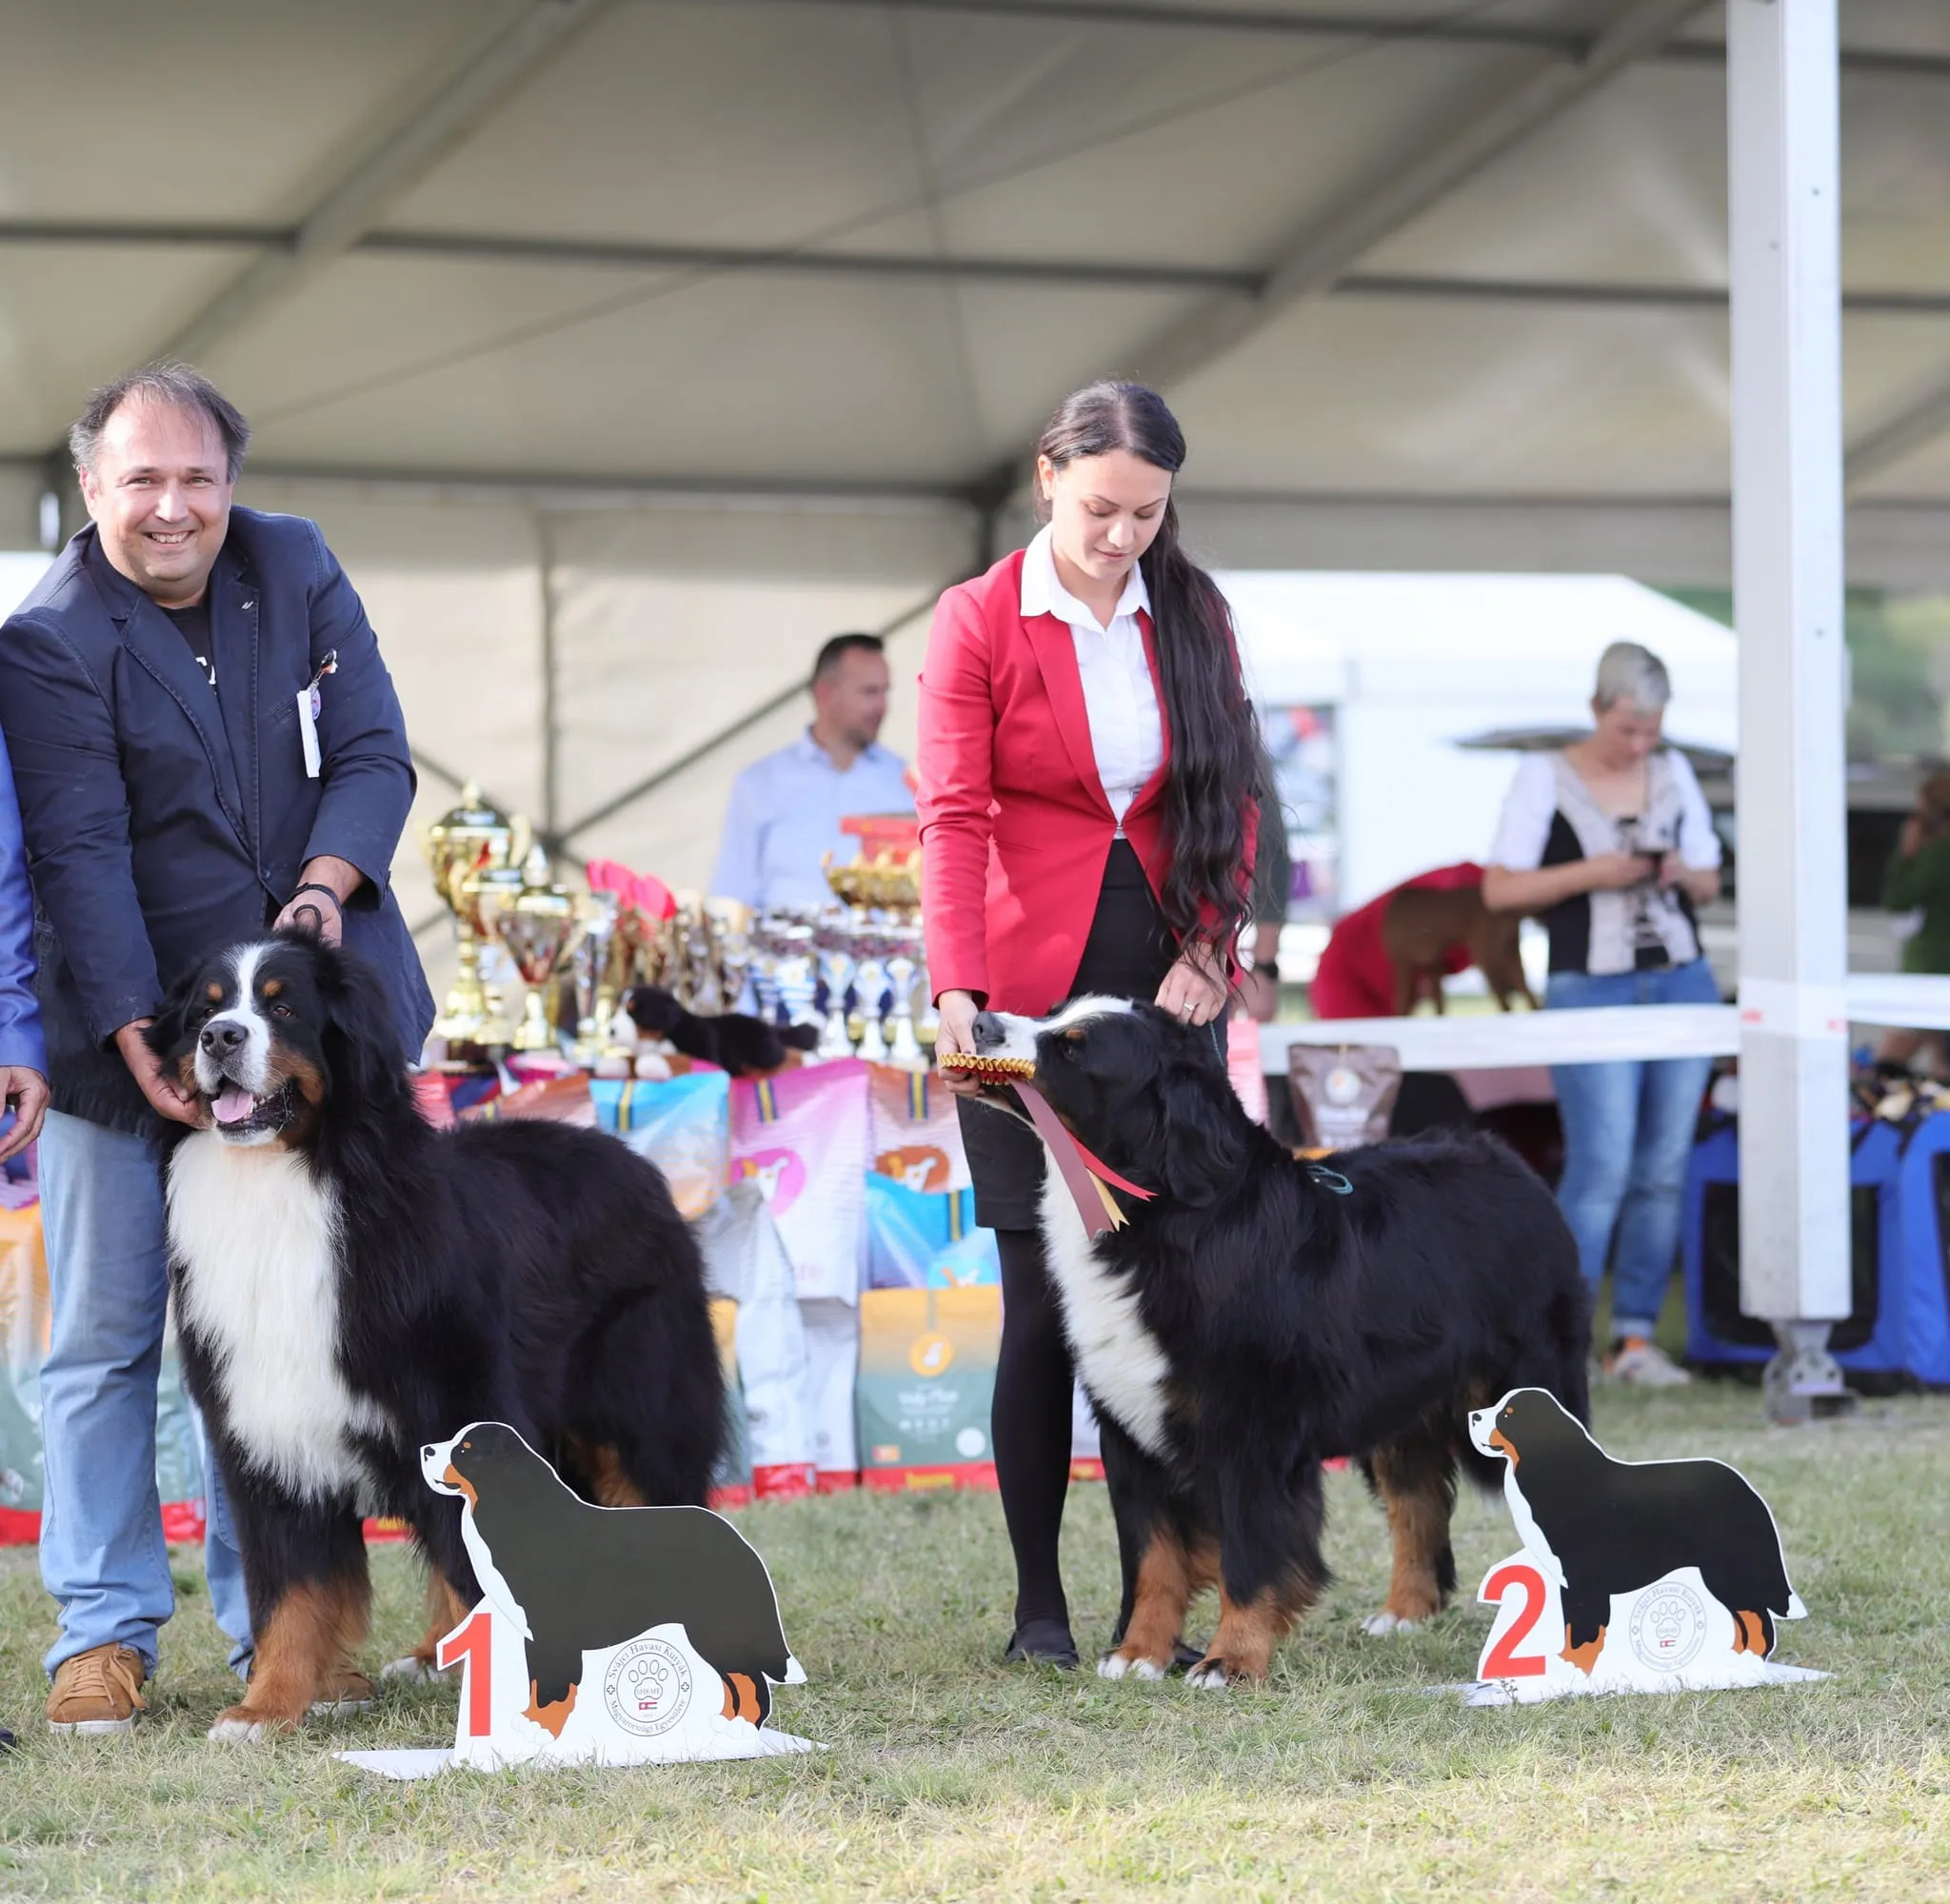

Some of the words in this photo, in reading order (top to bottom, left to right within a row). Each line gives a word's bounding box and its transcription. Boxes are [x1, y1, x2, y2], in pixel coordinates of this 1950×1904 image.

[443, 1613, 491, 1736] 1
[629, 1643, 662, 1655] Havasi
[664, 1646, 687, 1677] Kutyák
[1482, 1564, 1546, 1679] 2
